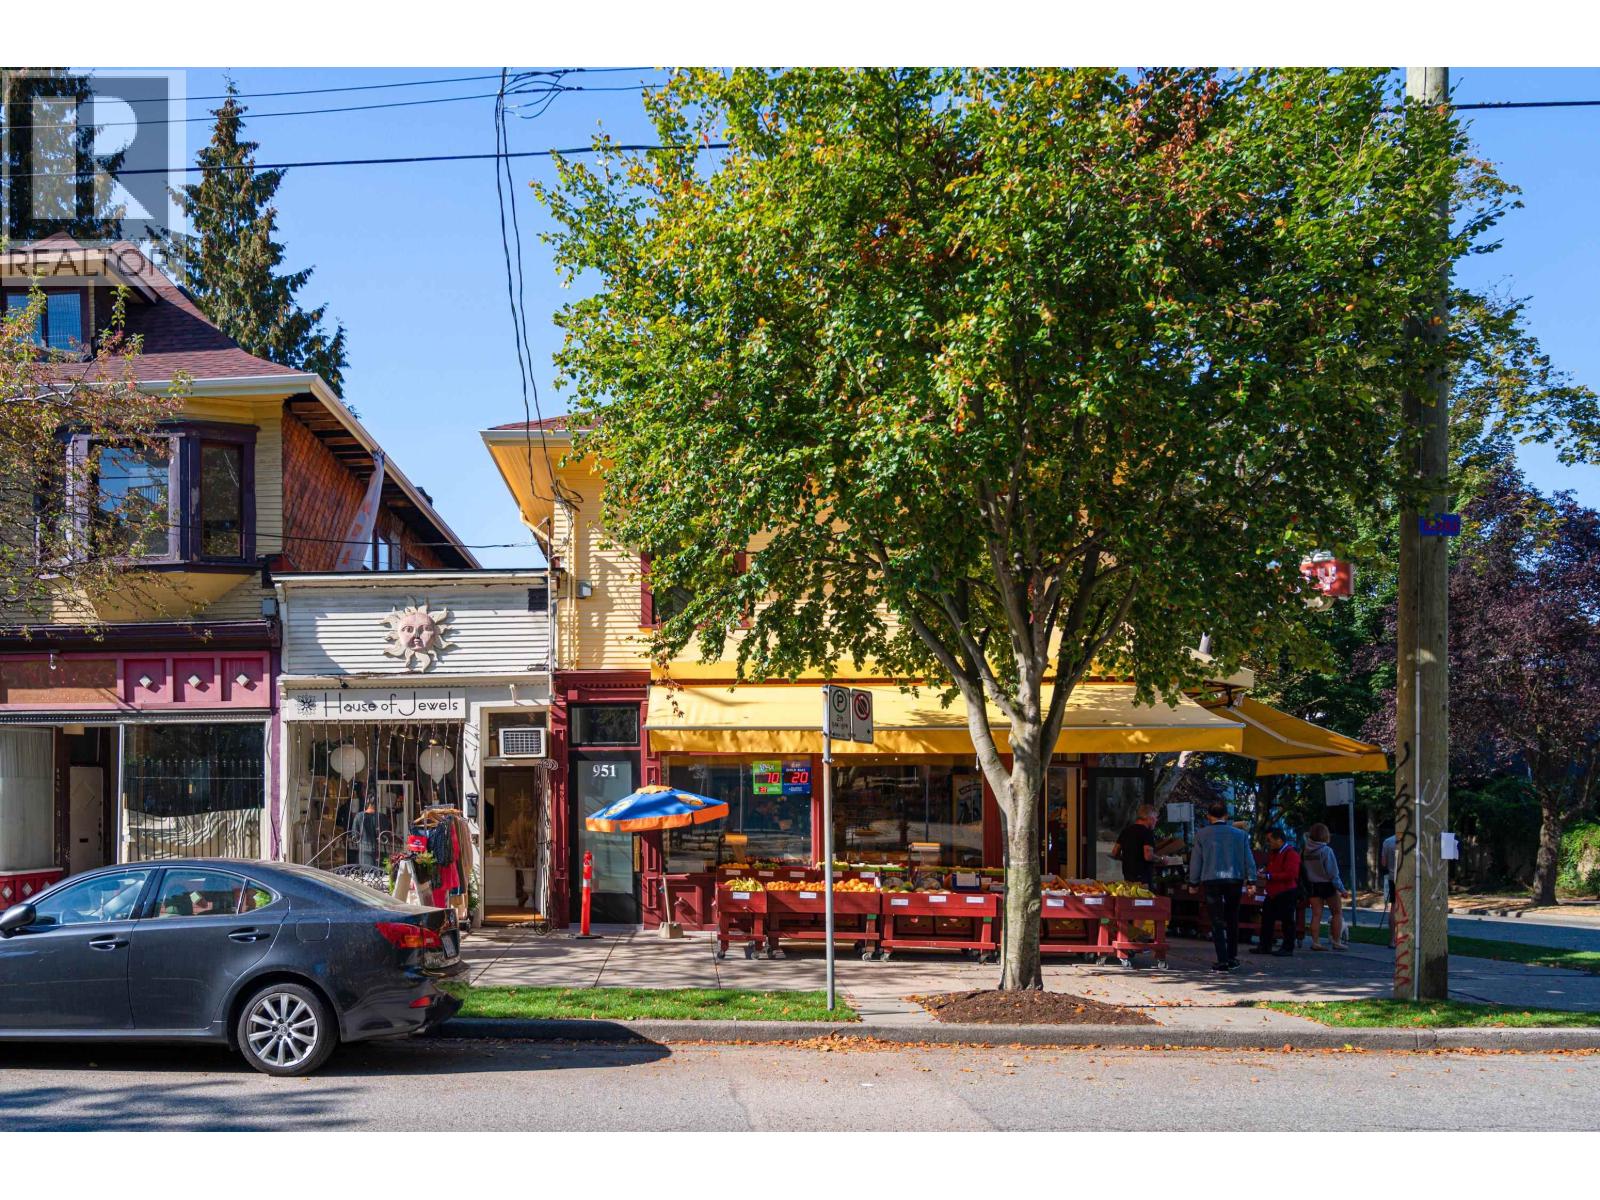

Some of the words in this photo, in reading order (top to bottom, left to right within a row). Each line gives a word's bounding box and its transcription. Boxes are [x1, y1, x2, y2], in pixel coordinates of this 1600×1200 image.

[381, 693, 397, 714] of
[398, 691, 459, 716] Jewels
[592, 764, 616, 777] 951
[791, 772, 809, 783] 20
